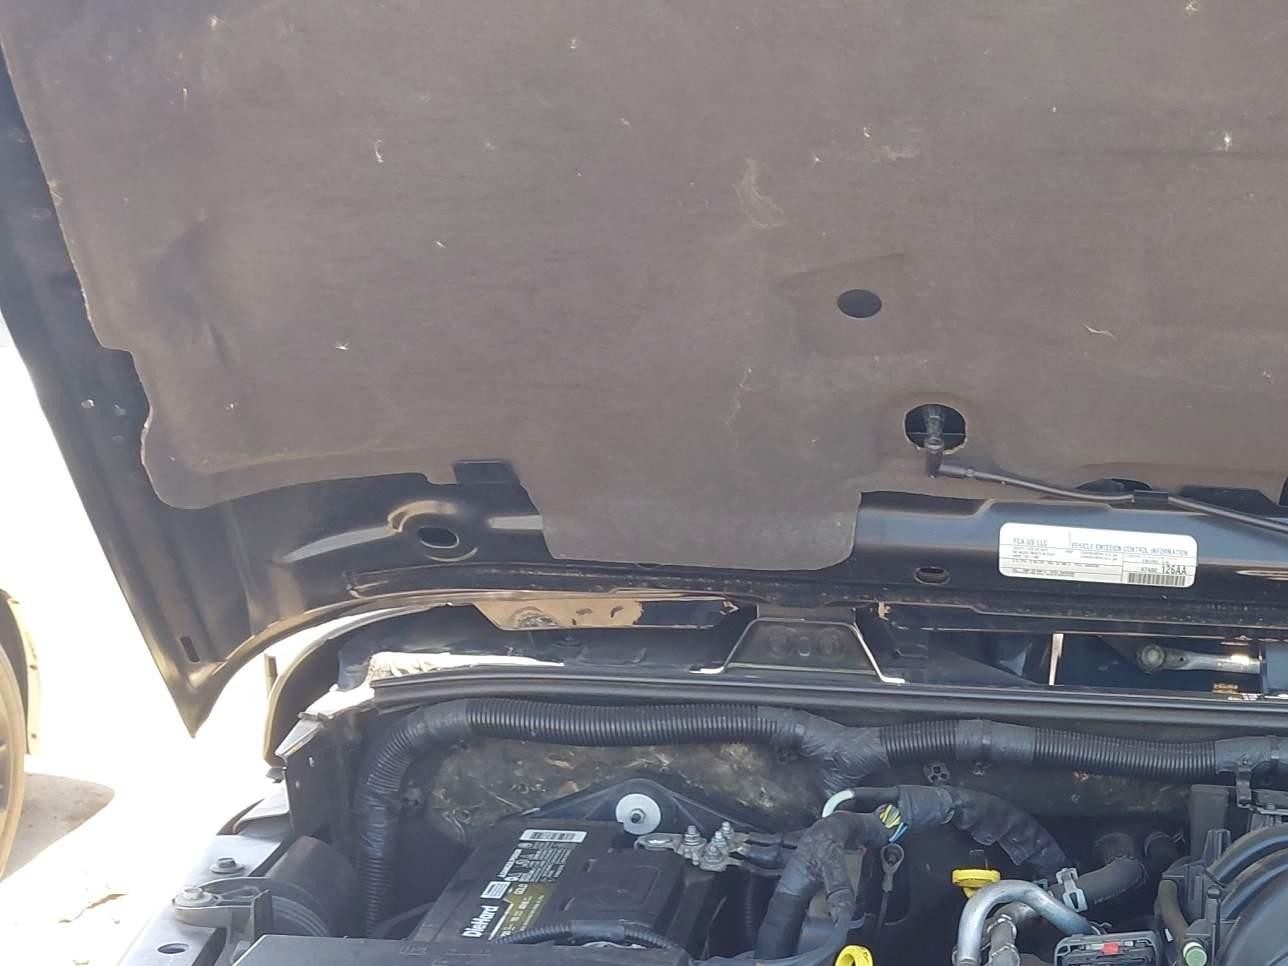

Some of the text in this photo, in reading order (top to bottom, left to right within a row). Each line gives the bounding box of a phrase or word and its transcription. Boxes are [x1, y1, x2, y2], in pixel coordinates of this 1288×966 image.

[1123, 546, 1149, 554] CONTROL
[1150, 547, 1188, 557] INFORMATION
[1161, 564, 1187, 576] 126AA
[461, 905, 500, 938] DieHard
